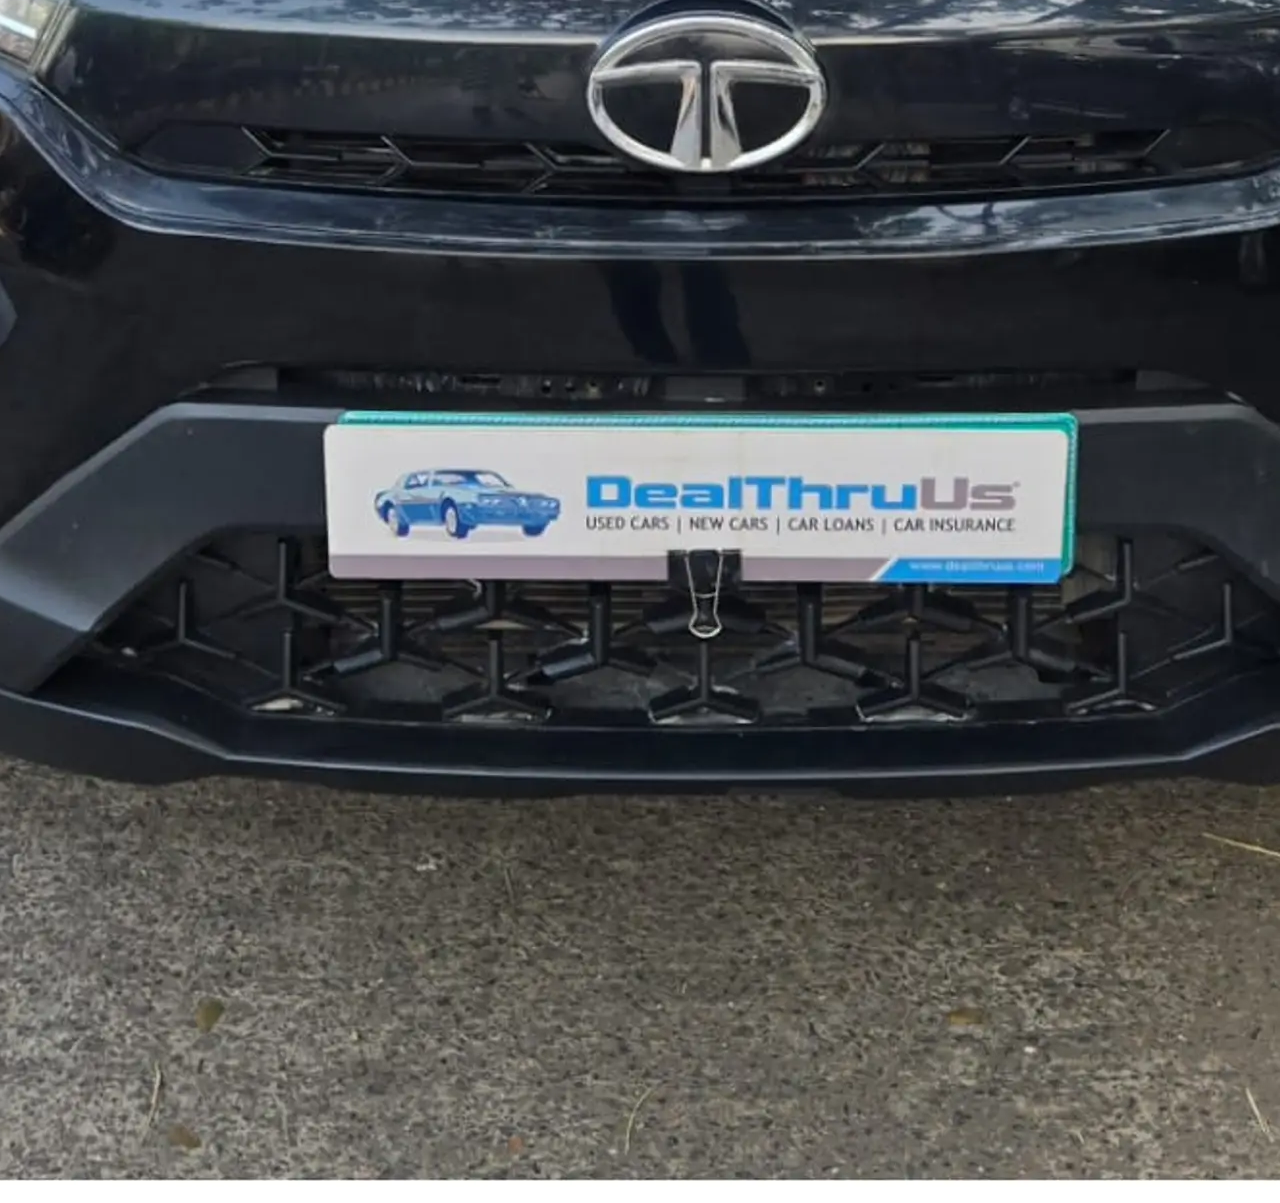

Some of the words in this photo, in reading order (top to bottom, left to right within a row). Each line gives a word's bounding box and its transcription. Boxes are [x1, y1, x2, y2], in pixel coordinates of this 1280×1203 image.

[586, 475, 1016, 511] DealThruUs
[585, 515, 626, 531] USED
[629, 515, 670, 531] CARS
[688, 516, 725, 531] NEW
[728, 516, 769, 531] CARS
[787, 516, 819, 532] CAR
[823, 516, 875, 532] LOANS
[893, 516, 926, 532] CAR
[929, 516, 1016, 532] INSURANCE
